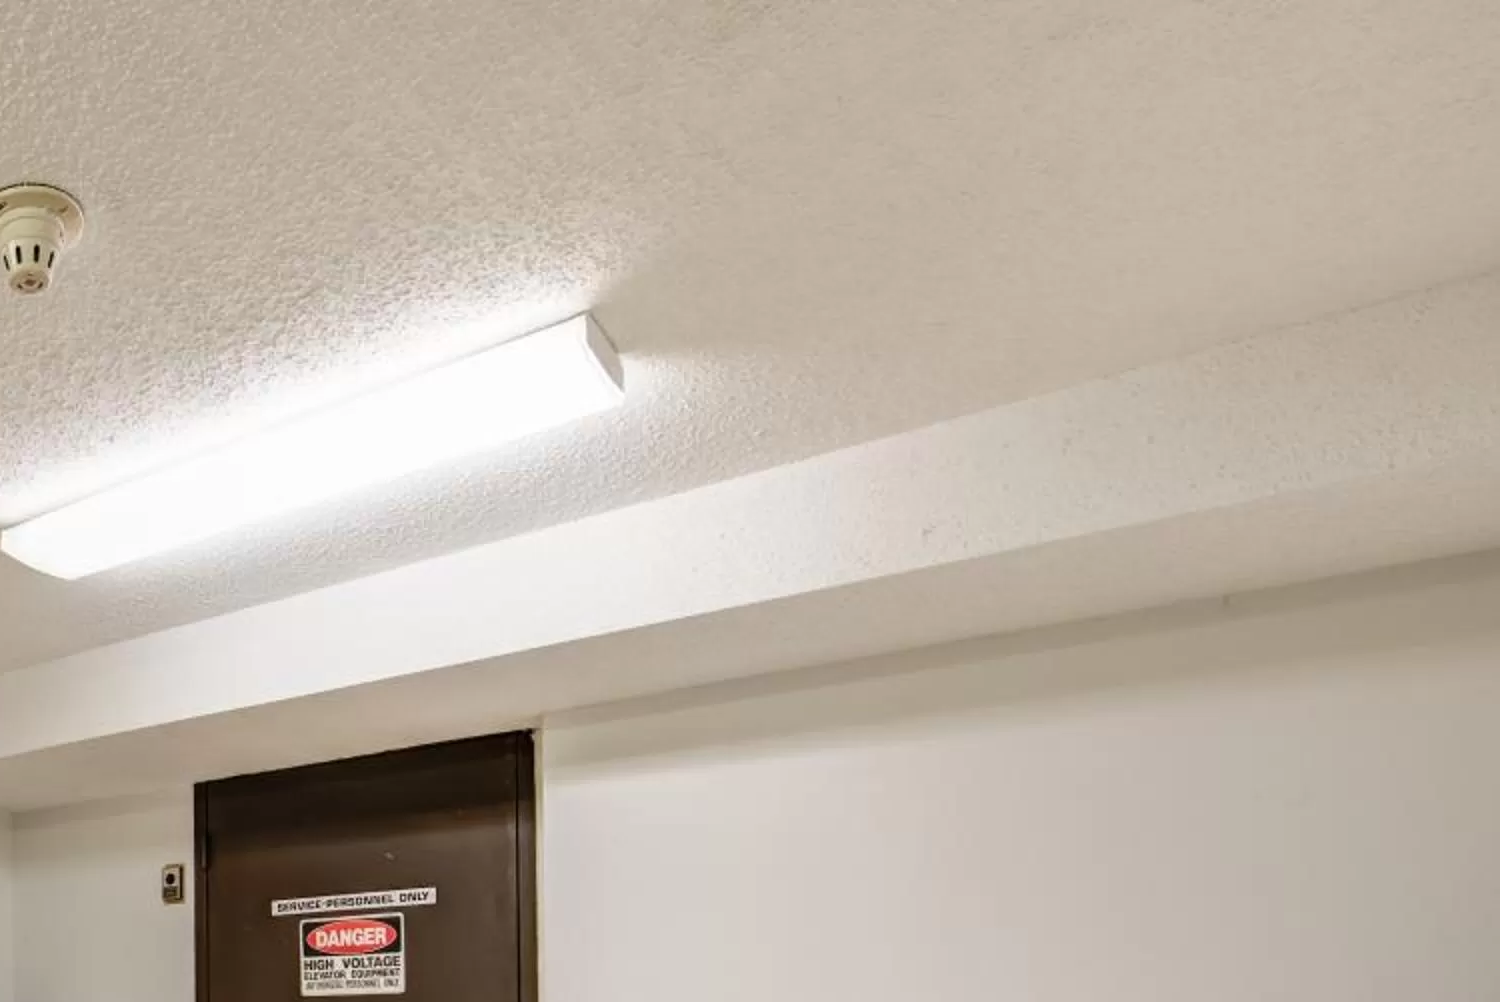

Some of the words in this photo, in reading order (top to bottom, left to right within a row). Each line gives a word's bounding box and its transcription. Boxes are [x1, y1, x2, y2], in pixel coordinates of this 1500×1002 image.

[277, 899, 321, 912] SERVICE
[326, 893, 394, 909] PERSONNEL
[399, 891, 429, 903] ONLY
[315, 927, 387, 947] DANGER
[304, 959, 334, 971] HIGH
[342, 956, 401, 969] VOLTAGE
[304, 969, 346, 981] ELEVATOR
[351, 968, 401, 979] EQUIPMENT
